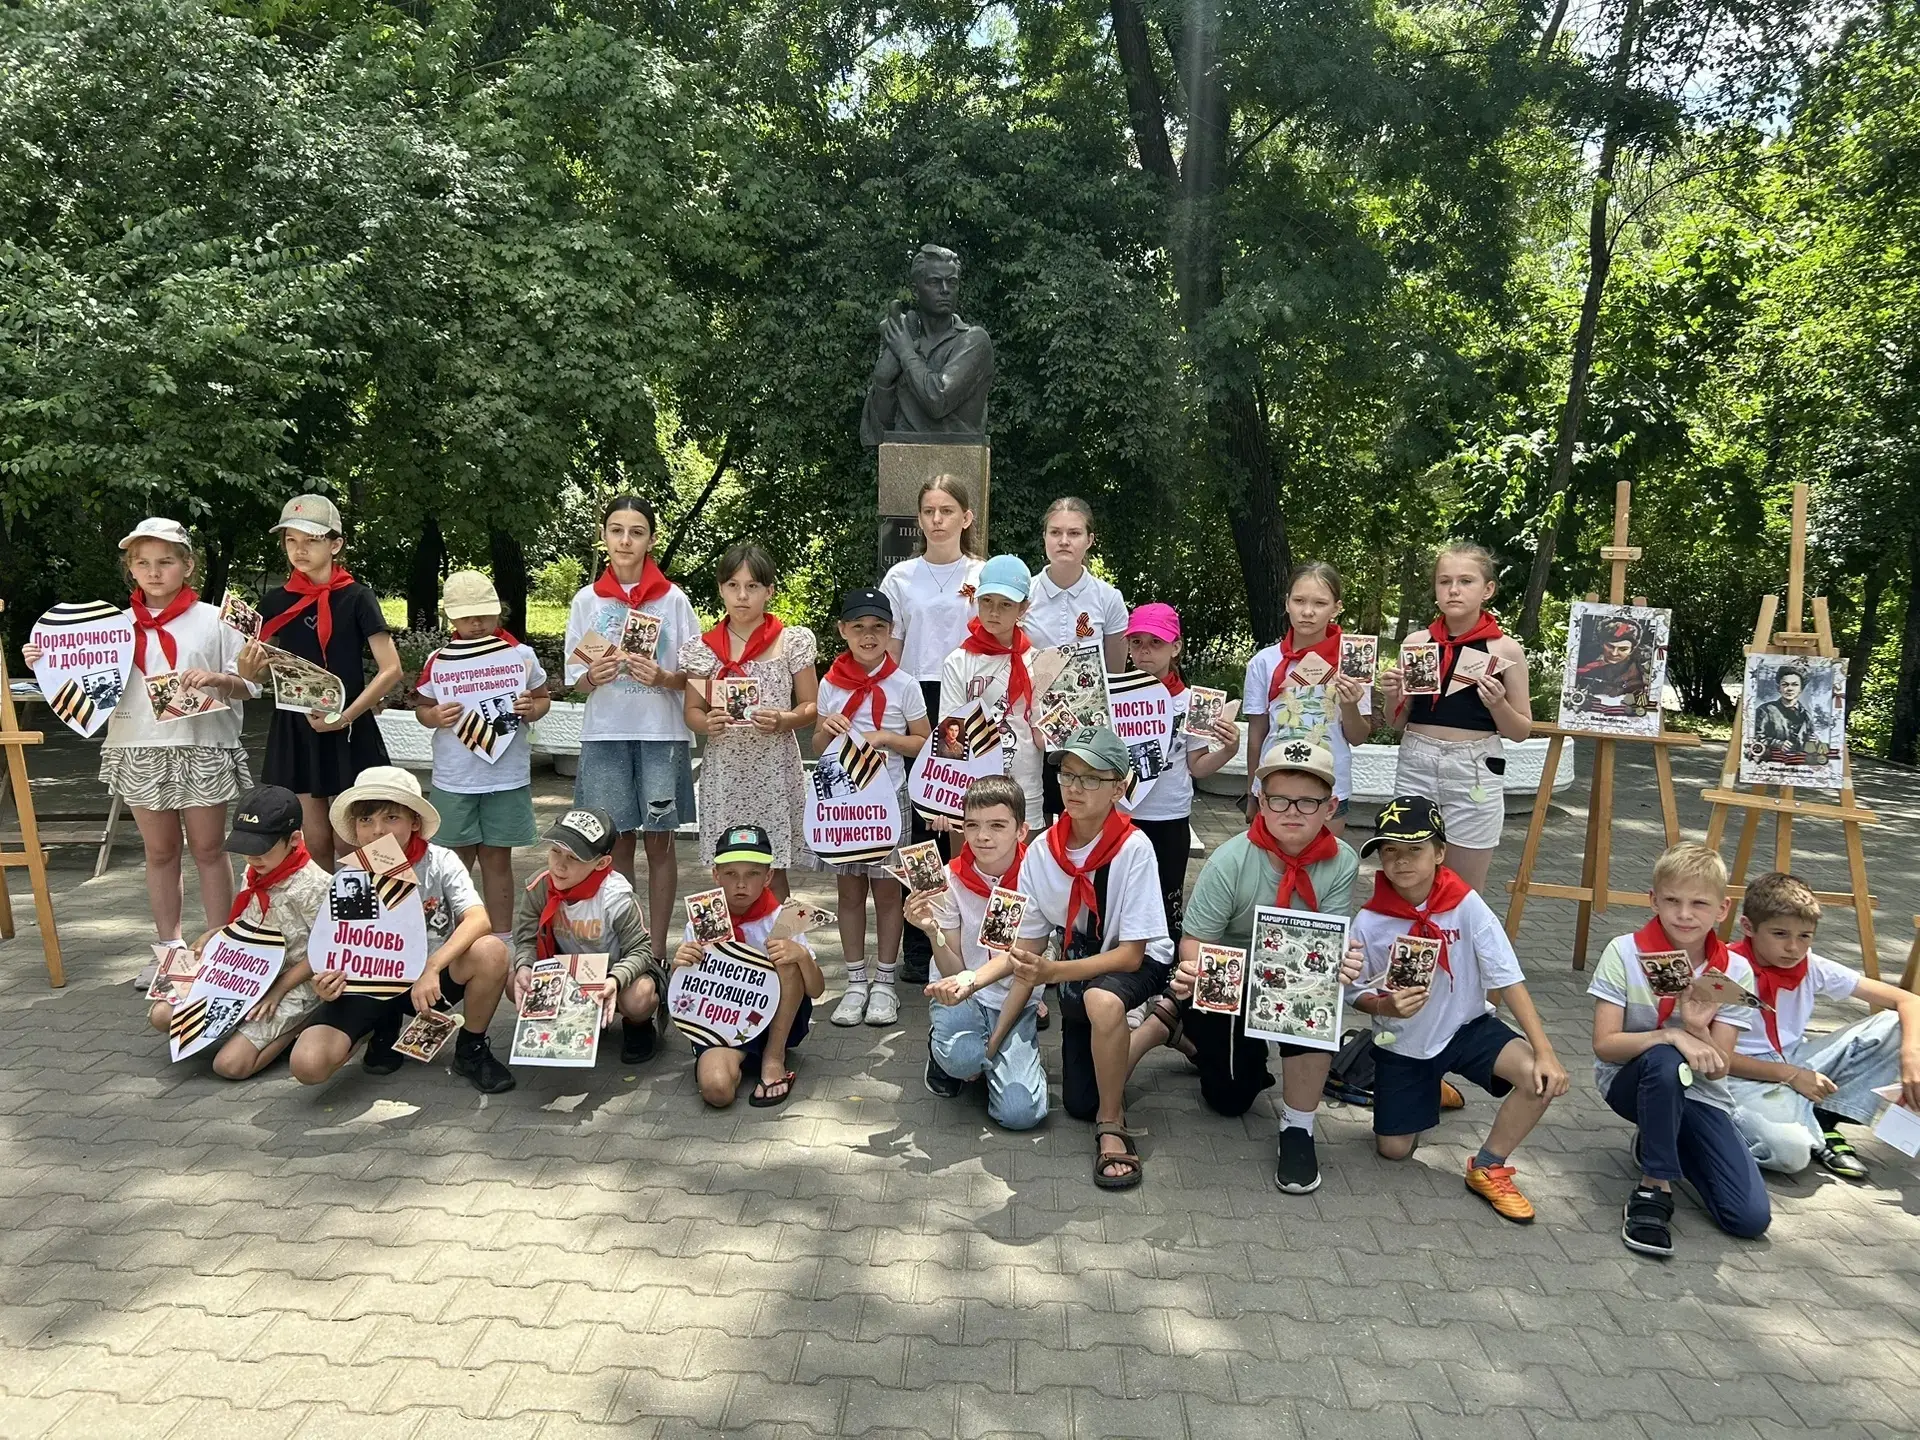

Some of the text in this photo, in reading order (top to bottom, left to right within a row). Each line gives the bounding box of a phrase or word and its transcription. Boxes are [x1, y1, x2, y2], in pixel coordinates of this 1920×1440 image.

[34, 629, 131, 651] Порядочность
[49, 649, 119, 669] и доброта
[433, 663, 524, 685] Целеустремлённость
[443, 677, 519, 697] и решительность
[1112, 700, 1154, 717] ность
[1115, 720, 1166, 737] мность
[921, 757, 976, 789] Доблес
[923, 783, 934, 799] и
[238, 813, 259, 823] FILA
[571, 813, 601, 832] DUCKS
[816, 802, 887, 822] Стойкость
[813, 826, 892, 846] и мужество
[1261, 914, 1342, 932] МАРШРУТ ГЕРОЕВ-ПИОНЕРОВ
[334, 921, 404, 951] Любовь
[210, 941, 270, 976] Храбрость
[326, 948, 405, 978] к Родине
[698, 953, 767, 987] Качества
[197, 965, 260, 997] и смелость
[681, 974, 768, 1010] настоящего
[696, 997, 740, 1025] Героя
